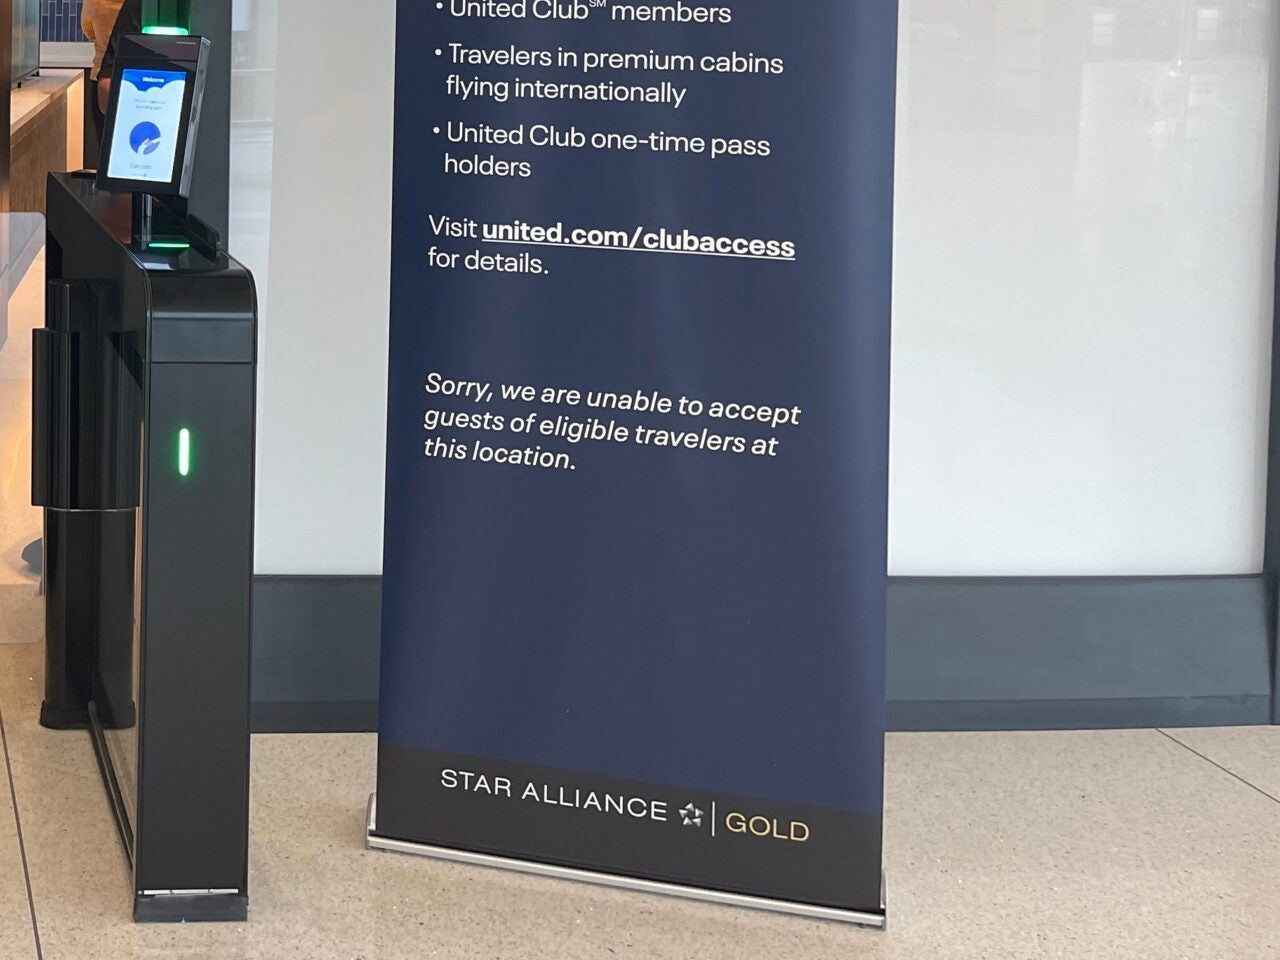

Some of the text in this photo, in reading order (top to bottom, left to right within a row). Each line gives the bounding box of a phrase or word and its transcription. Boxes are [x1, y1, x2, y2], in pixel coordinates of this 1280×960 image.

[612, 1, 731, 22] members
[449, 43, 783, 73] Travelers in premium cabins
[446, 75, 686, 108] flying internationally
[448, 122, 770, 158] United Club one-time pass
[445, 153, 530, 177] holders
[429, 215, 796, 260] Visit united.com/clubaccess
[428, 247, 548, 274] for details.
[426, 373, 801, 428] Sorry, we are unable to accept
[424, 410, 778, 456] guests of eligible travelers at
[425, 437, 577, 470] this location.
[442, 769, 809, 841] STAR ALLIANCE GOLD
